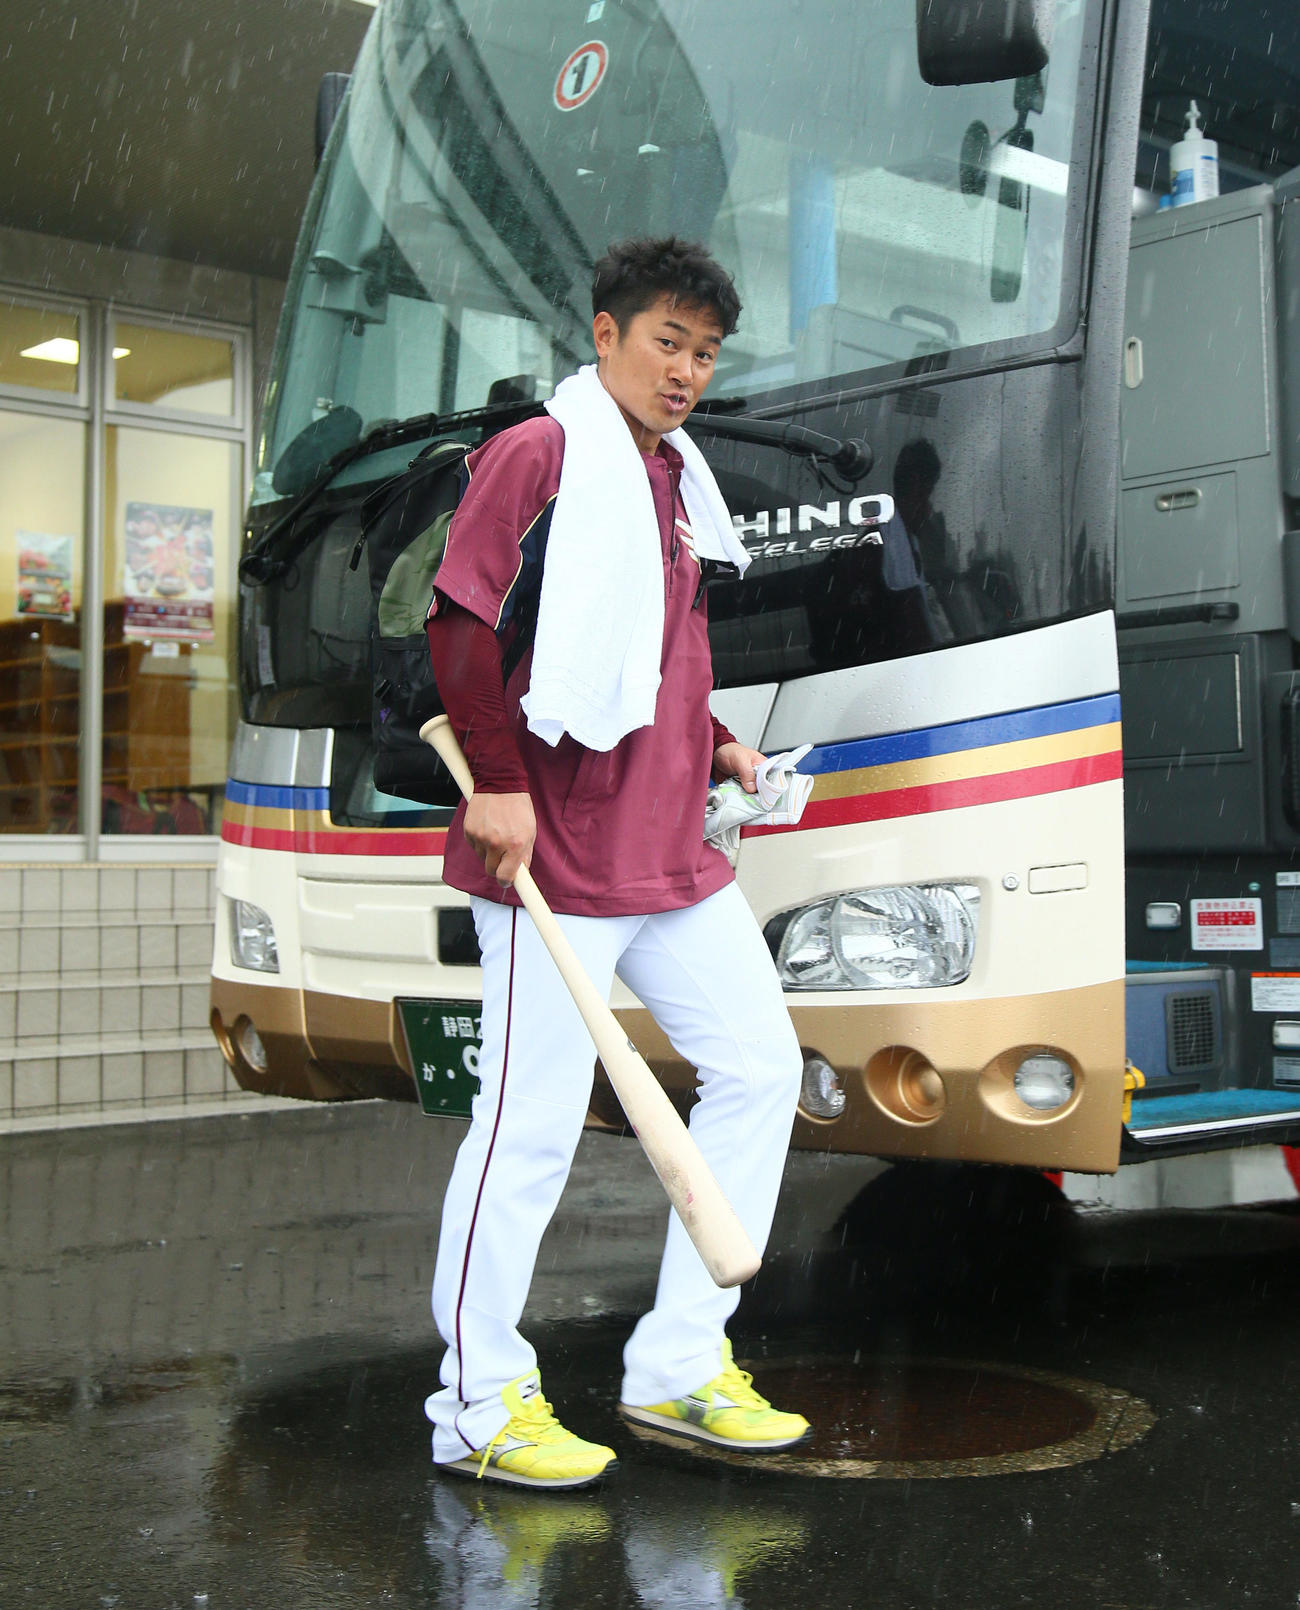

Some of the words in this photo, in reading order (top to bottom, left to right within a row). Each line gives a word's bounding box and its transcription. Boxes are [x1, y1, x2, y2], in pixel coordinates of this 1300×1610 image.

[573, 55, 590, 95] 1
[732, 493, 895, 541] HINO
[422, 1062, 436, 1082] か
